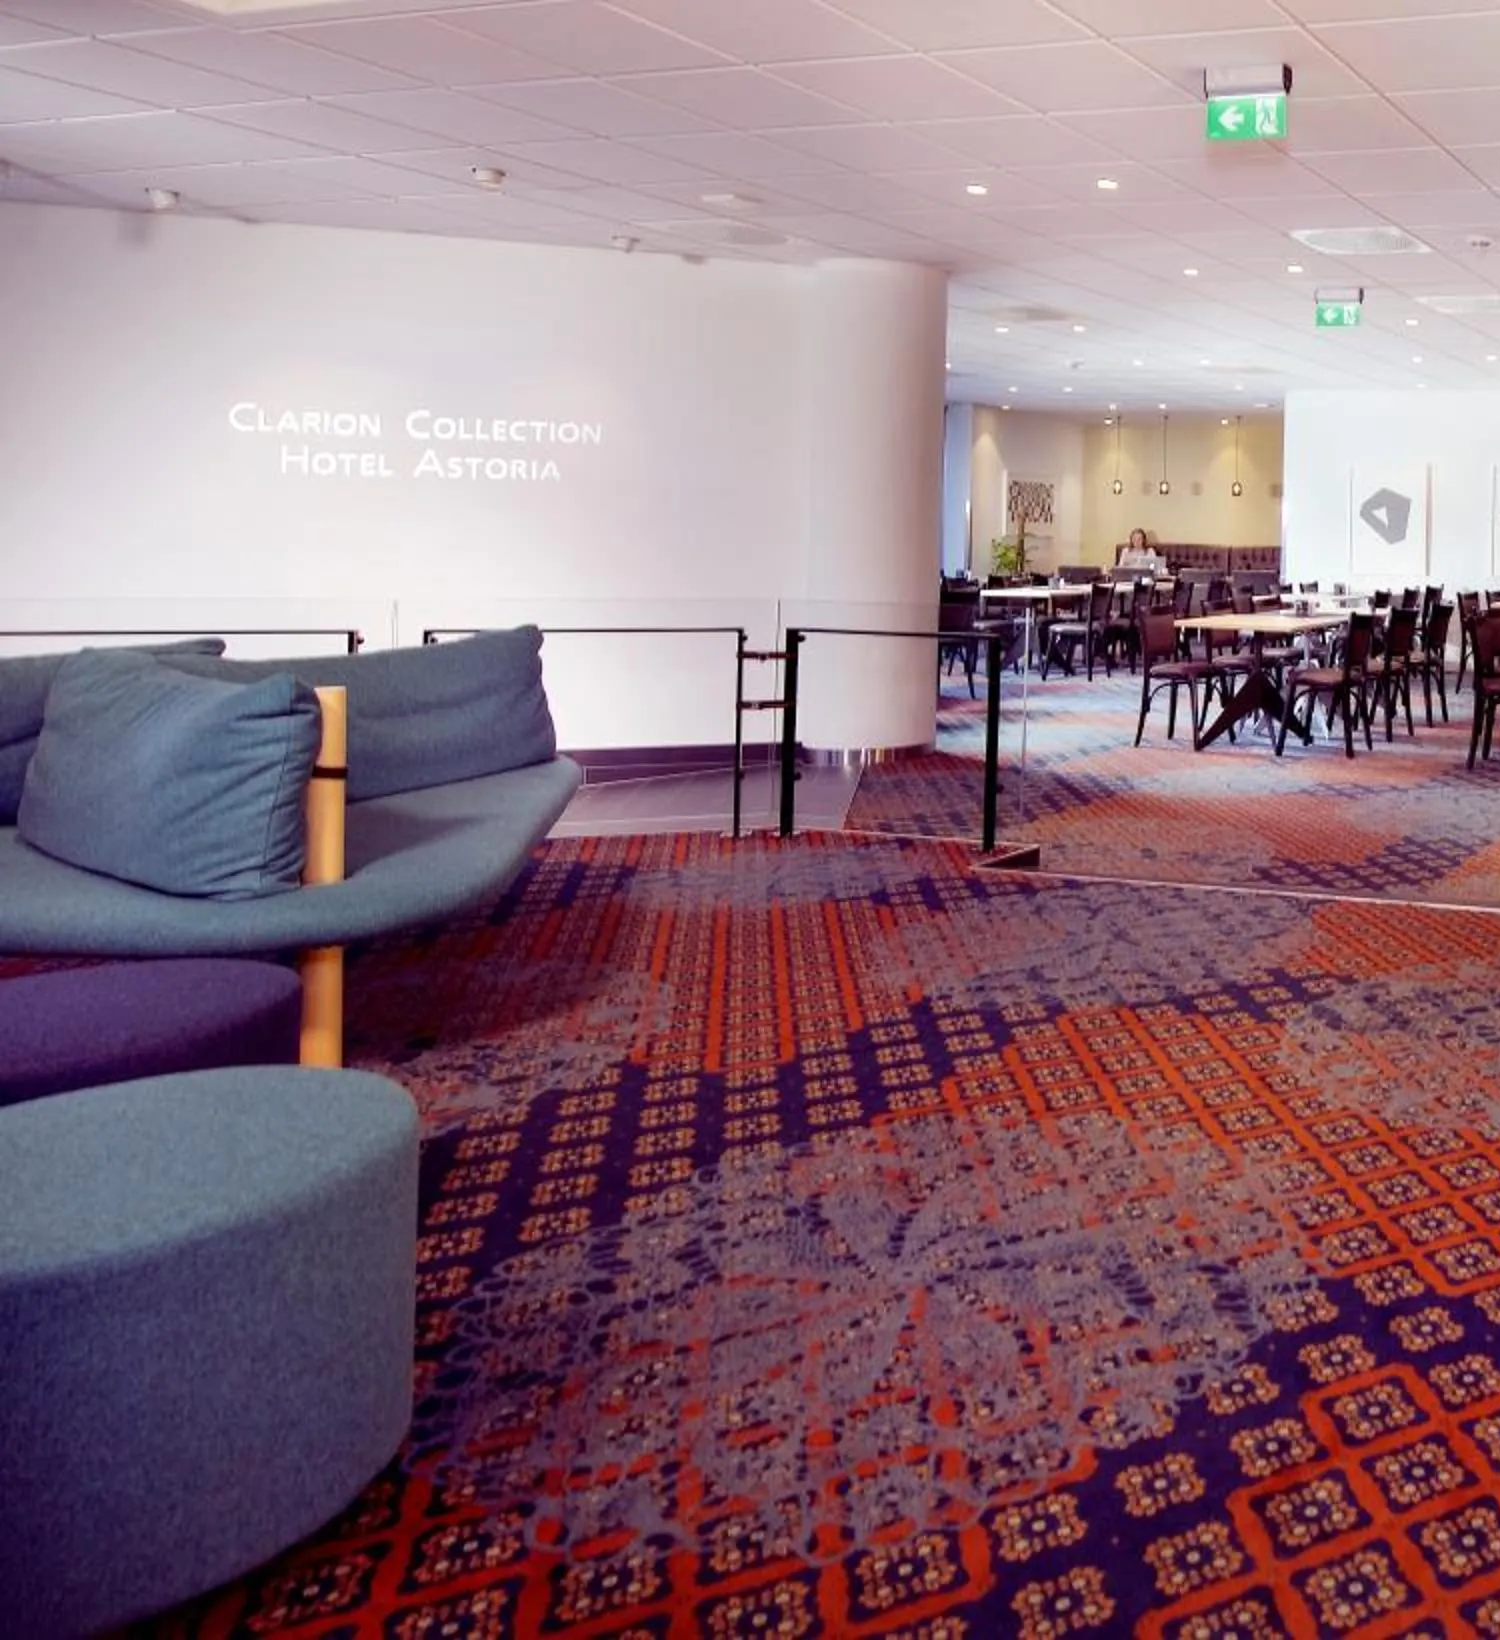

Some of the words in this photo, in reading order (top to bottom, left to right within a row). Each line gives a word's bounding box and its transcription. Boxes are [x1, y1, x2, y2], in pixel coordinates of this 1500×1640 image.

[228, 402, 382, 437] CLARION
[405, 409, 603, 445] COLLECTION
[281, 444, 393, 478] HOTEL
[413, 448, 561, 481] ASTORIA
